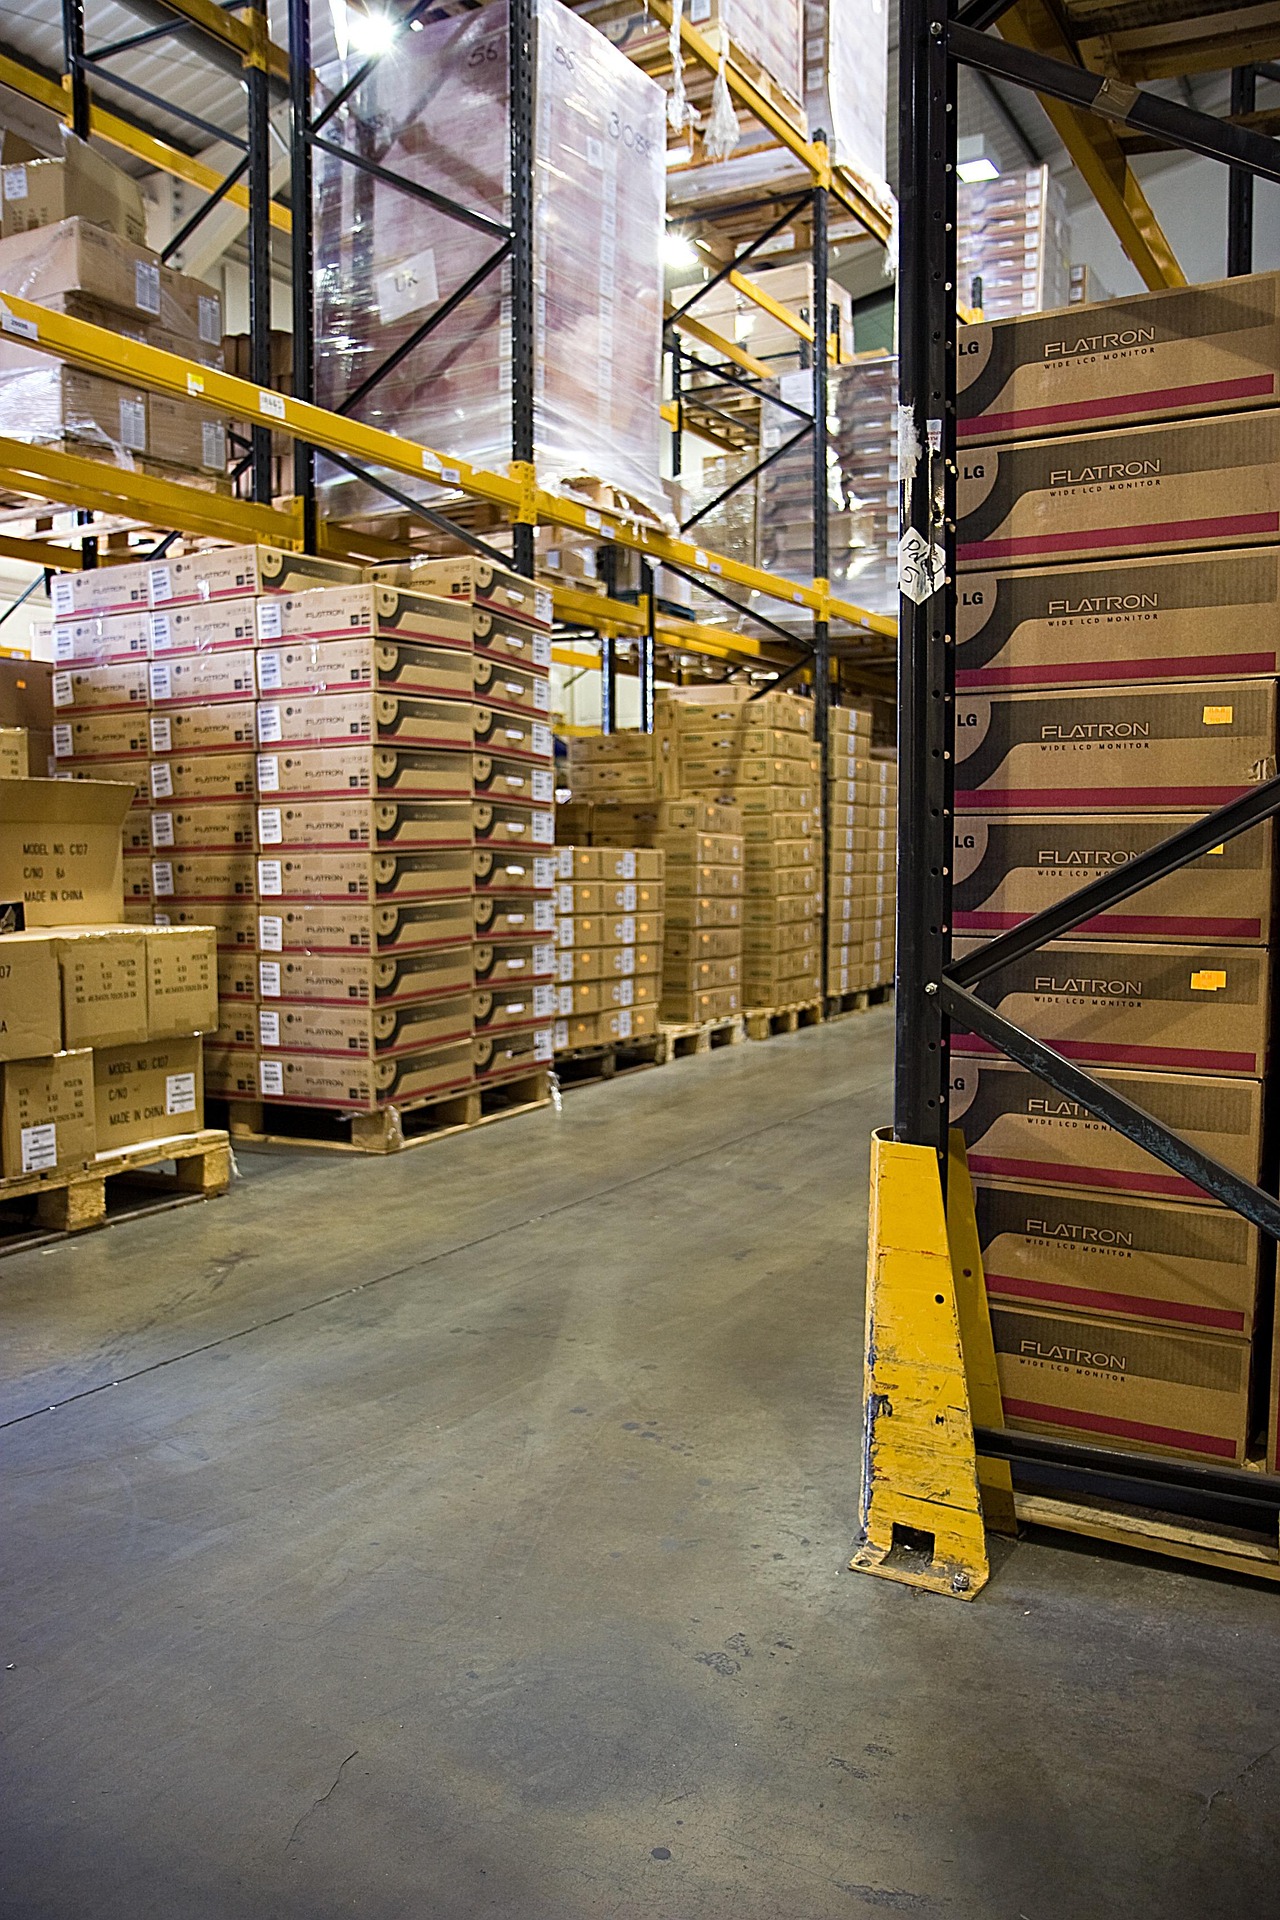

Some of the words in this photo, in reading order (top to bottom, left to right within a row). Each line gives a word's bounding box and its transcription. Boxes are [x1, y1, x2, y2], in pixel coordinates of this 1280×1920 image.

[957, 340, 980, 356] LG
[1044, 327, 1155, 358] FLATRON
[1044, 359, 1072, 370] WIDE
[1076, 356, 1097, 365] LCD
[1103, 347, 1156, 362] MONITOR
[963, 465, 985, 480] LG
[1049, 459, 1162, 485] FLATRON
[1049, 489, 1076, 497] WIDE
[1082, 486, 1103, 494] LCD
[1109, 479, 1162, 491] MONITOR
[962, 591, 984, 606] LG
[1047, 593, 1159, 615] FLATRON
[1047, 619, 1074, 627] WIDE
[1080, 616, 1100, 625] LCD
[1107, 613, 1159, 624] MONITOR
[956, 713, 978, 728] LG
[1040, 722, 1150, 740] FLATRON
[1072, 743, 1092, 751] LCD
[1098, 742, 1150, 750] MONITOR
[23, 843, 49, 856] MODEL
[954, 835, 975, 849] LG
[24, 890, 46, 902] MADE
[50, 891, 58, 901] IN
[61, 890, 84, 902] CHINA
[1034, 977, 1143, 995] FLATRON
[1065, 998, 1085, 1006] LCD
[1091, 999, 1143, 1008] MONITOR
[108, 1061, 133, 1075] MODEL
[152, 1055, 169, 1070] C107
[109, 1111, 130, 1126] MADE
[134, 1109, 142, 1121] IN
[144, 1105, 165, 1119] CHINA
[1028, 1098, 1090, 1116] FLAT
[1027, 1118, 1052, 1126] WIDE
[1084, 1122, 1115, 1131] MONI
[1026, 1219, 1133, 1246] FLATRON
[1025, 1238, 1050, 1247] WIDE
[1057, 1241, 1076, 1250] LCD
[1082, 1246, 1133, 1258] MONITOR
[1020, 1340, 1126, 1371] FLATRON
[1019, 1358, 1044, 1369] WIDE
[1051, 1363, 1070, 1373] LCD
[1075, 1368, 1126, 1382] MONITOR
